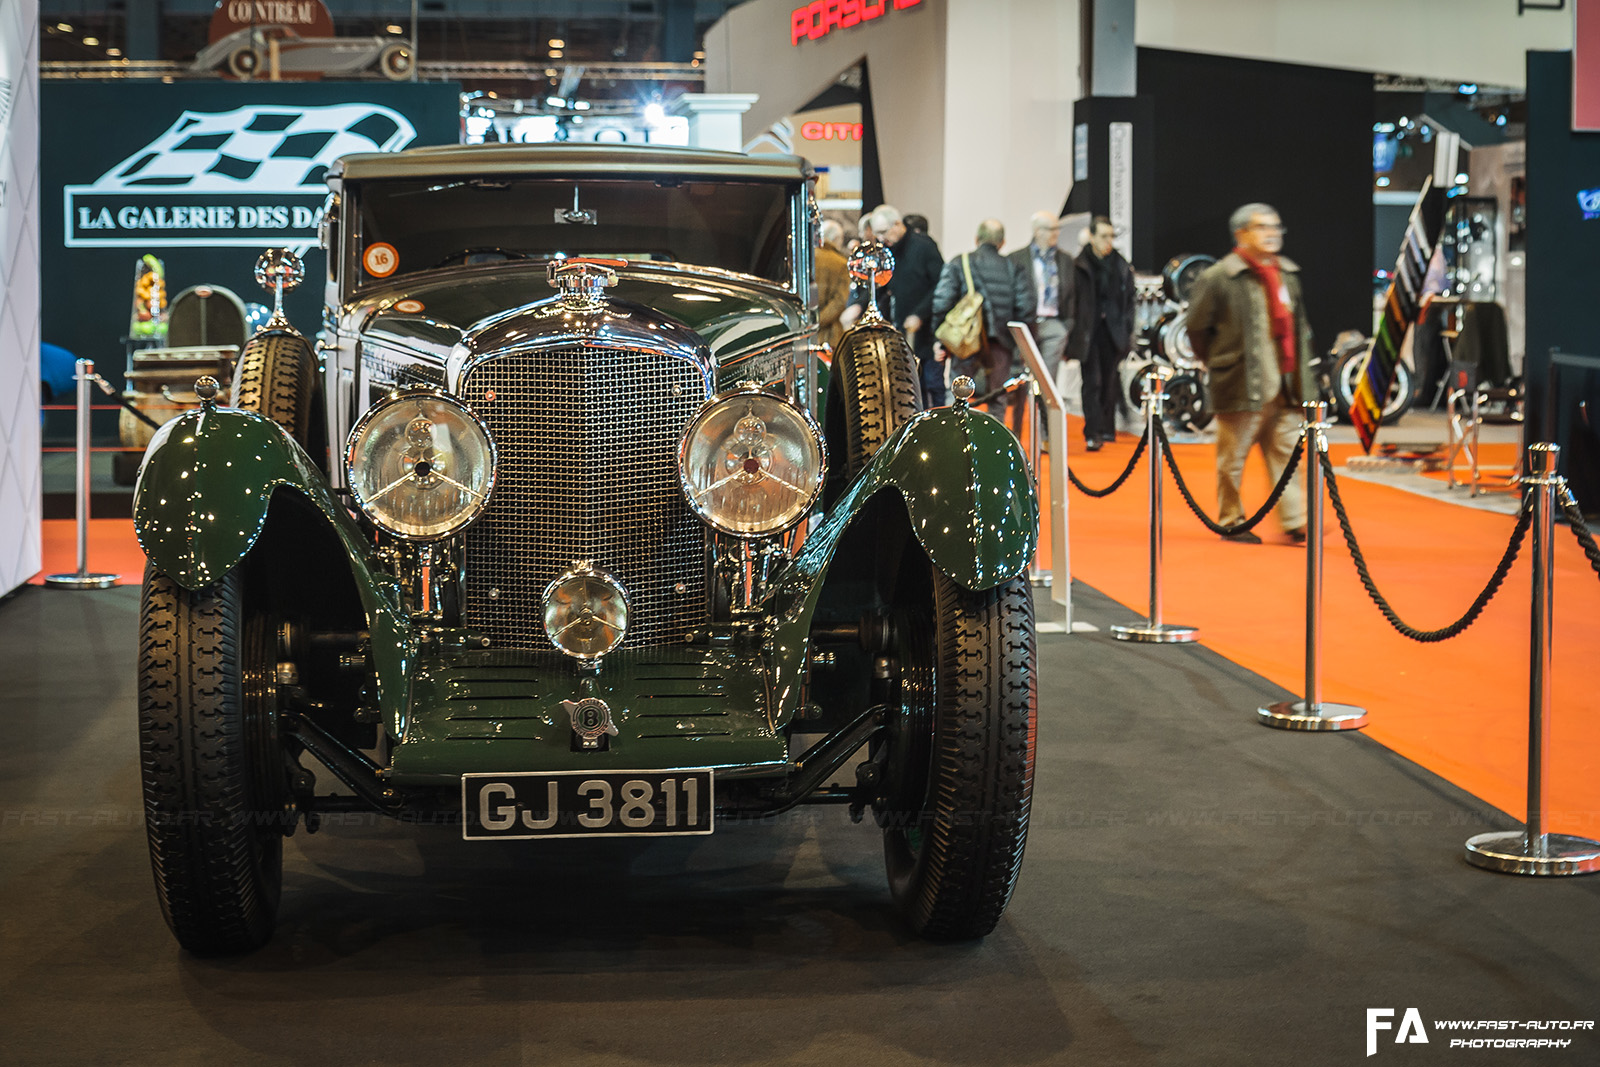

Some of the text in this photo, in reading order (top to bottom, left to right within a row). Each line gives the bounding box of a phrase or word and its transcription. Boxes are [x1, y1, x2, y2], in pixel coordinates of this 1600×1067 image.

[228, 0, 316, 25] CONTREAU
[78, 206, 116, 229] LA
[118, 206, 236, 229] GALERIE
[238, 206, 290, 229] DES
[374, 253, 389, 266] 16
[479, 778, 698, 831] GJ 3811
